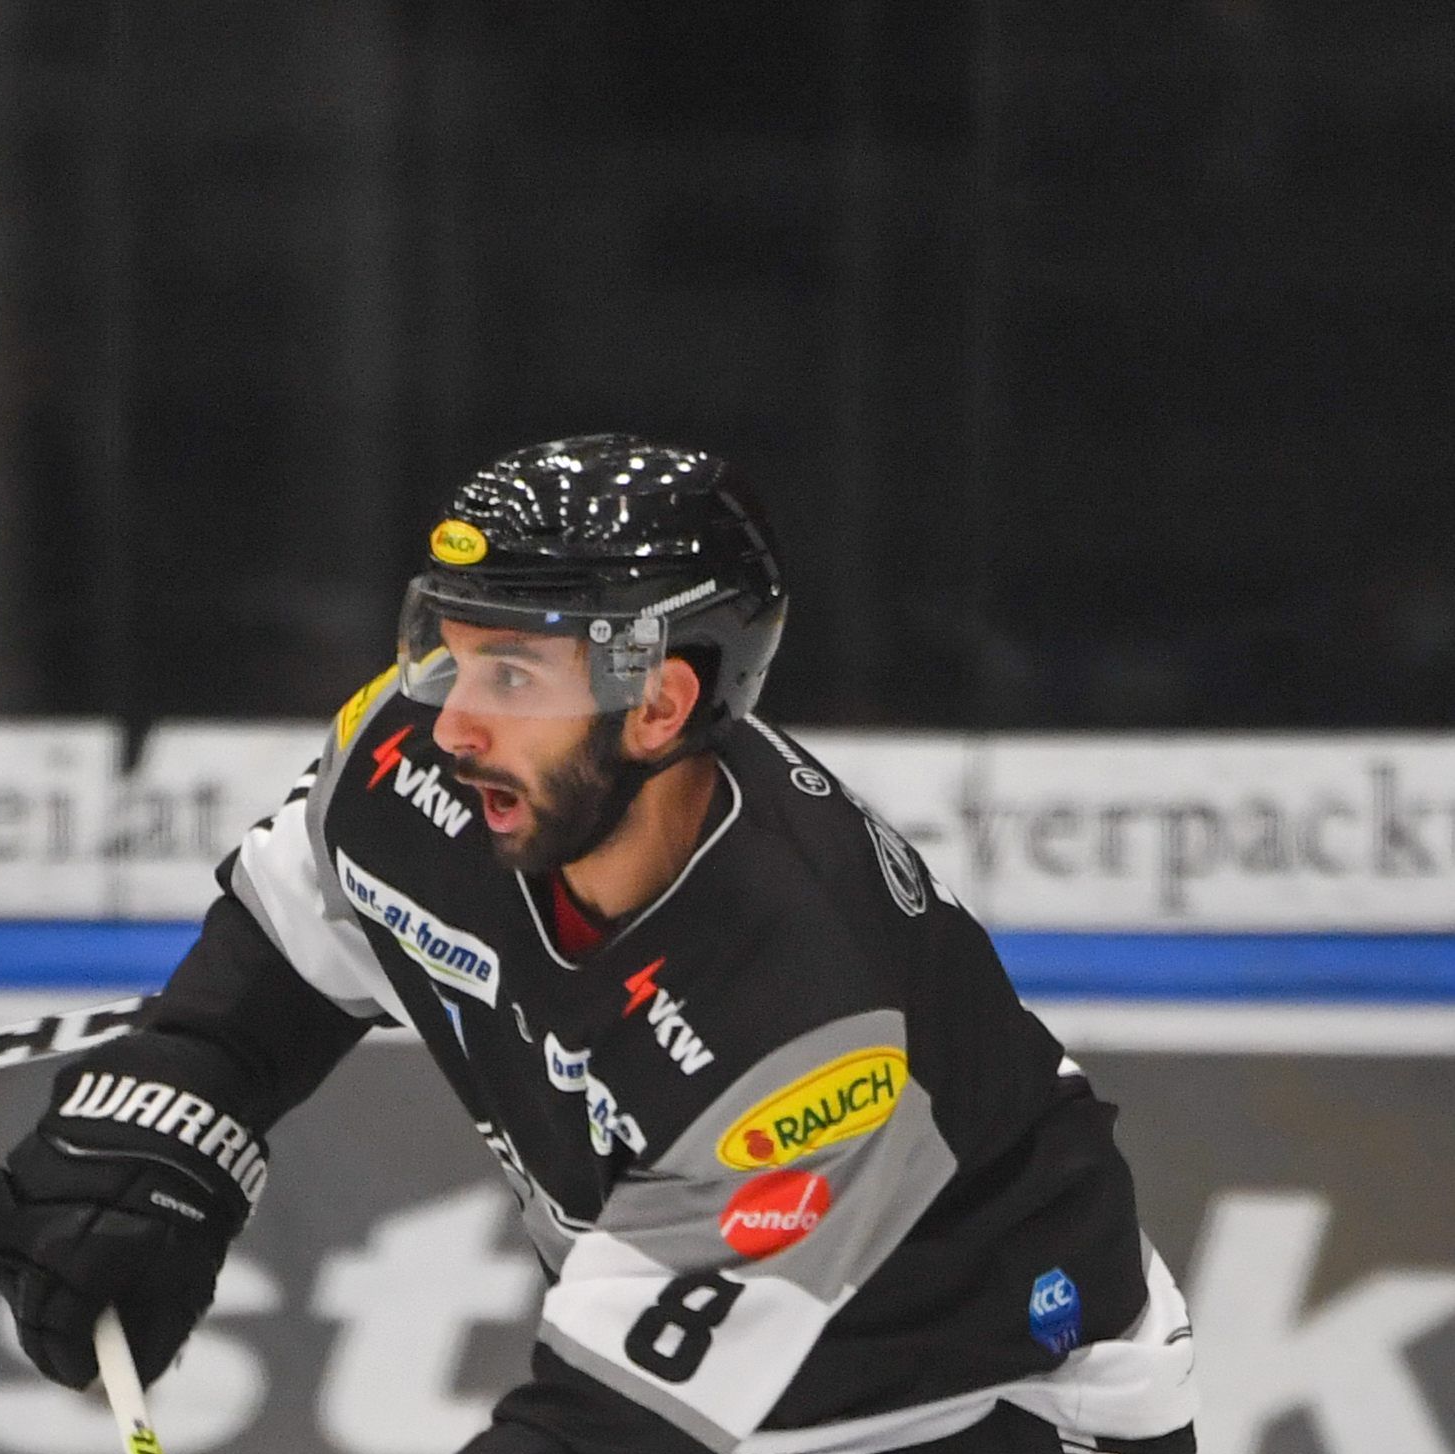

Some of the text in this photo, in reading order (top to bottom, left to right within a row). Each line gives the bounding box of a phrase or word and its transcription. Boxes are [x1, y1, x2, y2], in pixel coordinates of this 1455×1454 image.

[393, 755, 474, 839] vkw
[345, 866, 492, 984] bet-at-home
[647, 987, 716, 1077] vkw
[58, 1071, 269, 1206] WARRIO
[773, 1061, 895, 1152] RAUCH
[719, 1174, 819, 1239] rondo
[624, 1272, 746, 1384] 8
